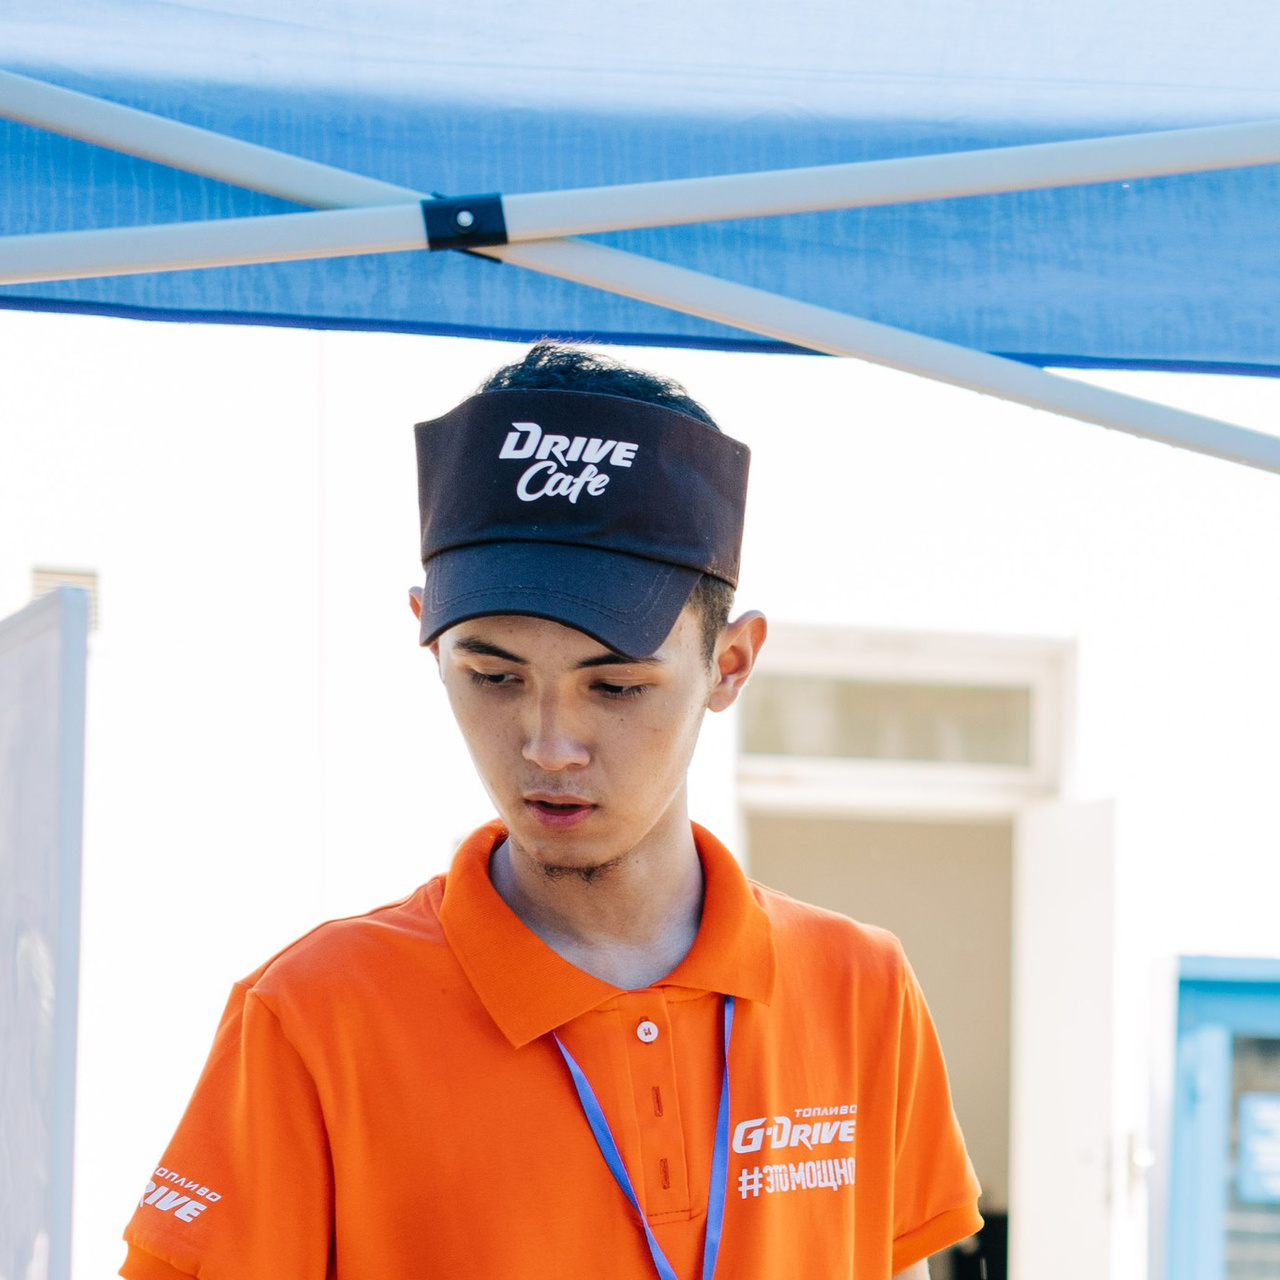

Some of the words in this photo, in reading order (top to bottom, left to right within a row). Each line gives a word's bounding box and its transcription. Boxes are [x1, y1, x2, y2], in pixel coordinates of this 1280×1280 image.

[499, 422, 639, 468] DRIVE
[516, 460, 610, 504] Cafe
[794, 1104, 858, 1119] ТОПЛИВО
[154, 1165, 222, 1203] ОПЛИВО
